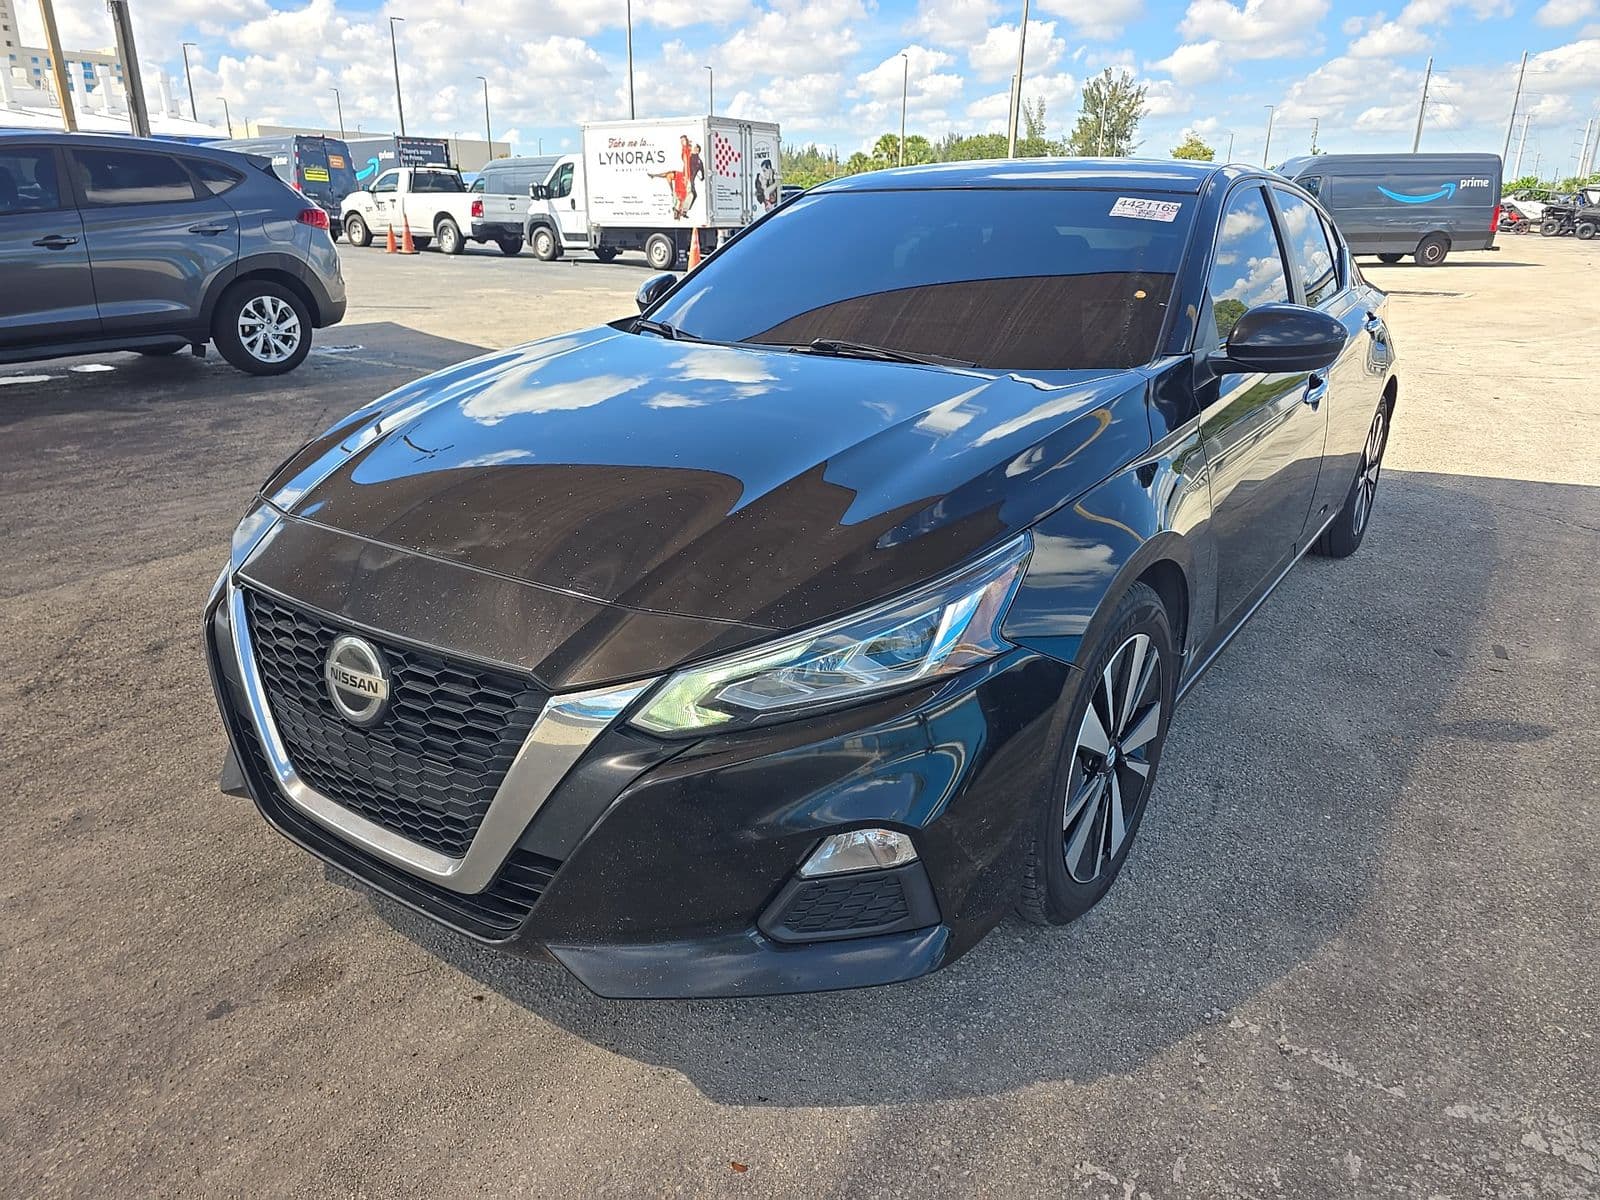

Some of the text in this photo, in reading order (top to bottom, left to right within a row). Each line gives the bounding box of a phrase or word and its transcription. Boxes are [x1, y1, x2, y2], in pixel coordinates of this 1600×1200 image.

[608, 137, 625, 148] Take
[599, 150, 666, 165] LYNORA'S
[1460, 176, 1489, 189] prime
[1120, 200, 1180, 213] 4421169
[330, 667, 378, 693] NISSAN
